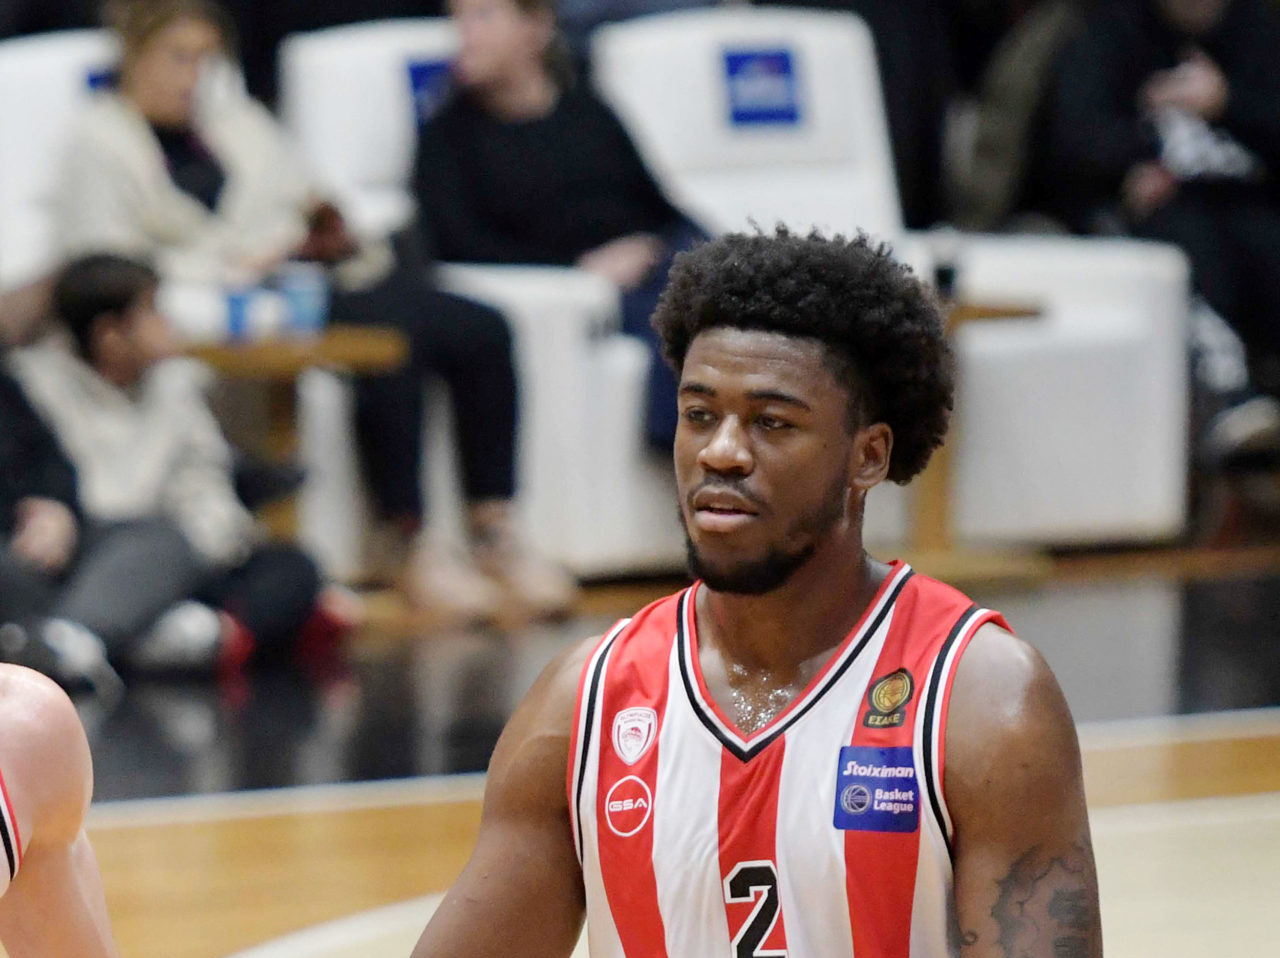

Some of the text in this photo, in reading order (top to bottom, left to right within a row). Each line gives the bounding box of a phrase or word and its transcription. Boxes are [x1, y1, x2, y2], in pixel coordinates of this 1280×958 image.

[843, 760, 914, 778] Stoiximan
[874, 788, 914, 801] Basket
[609, 797, 648, 812] GSA
[873, 800, 914, 814] League
